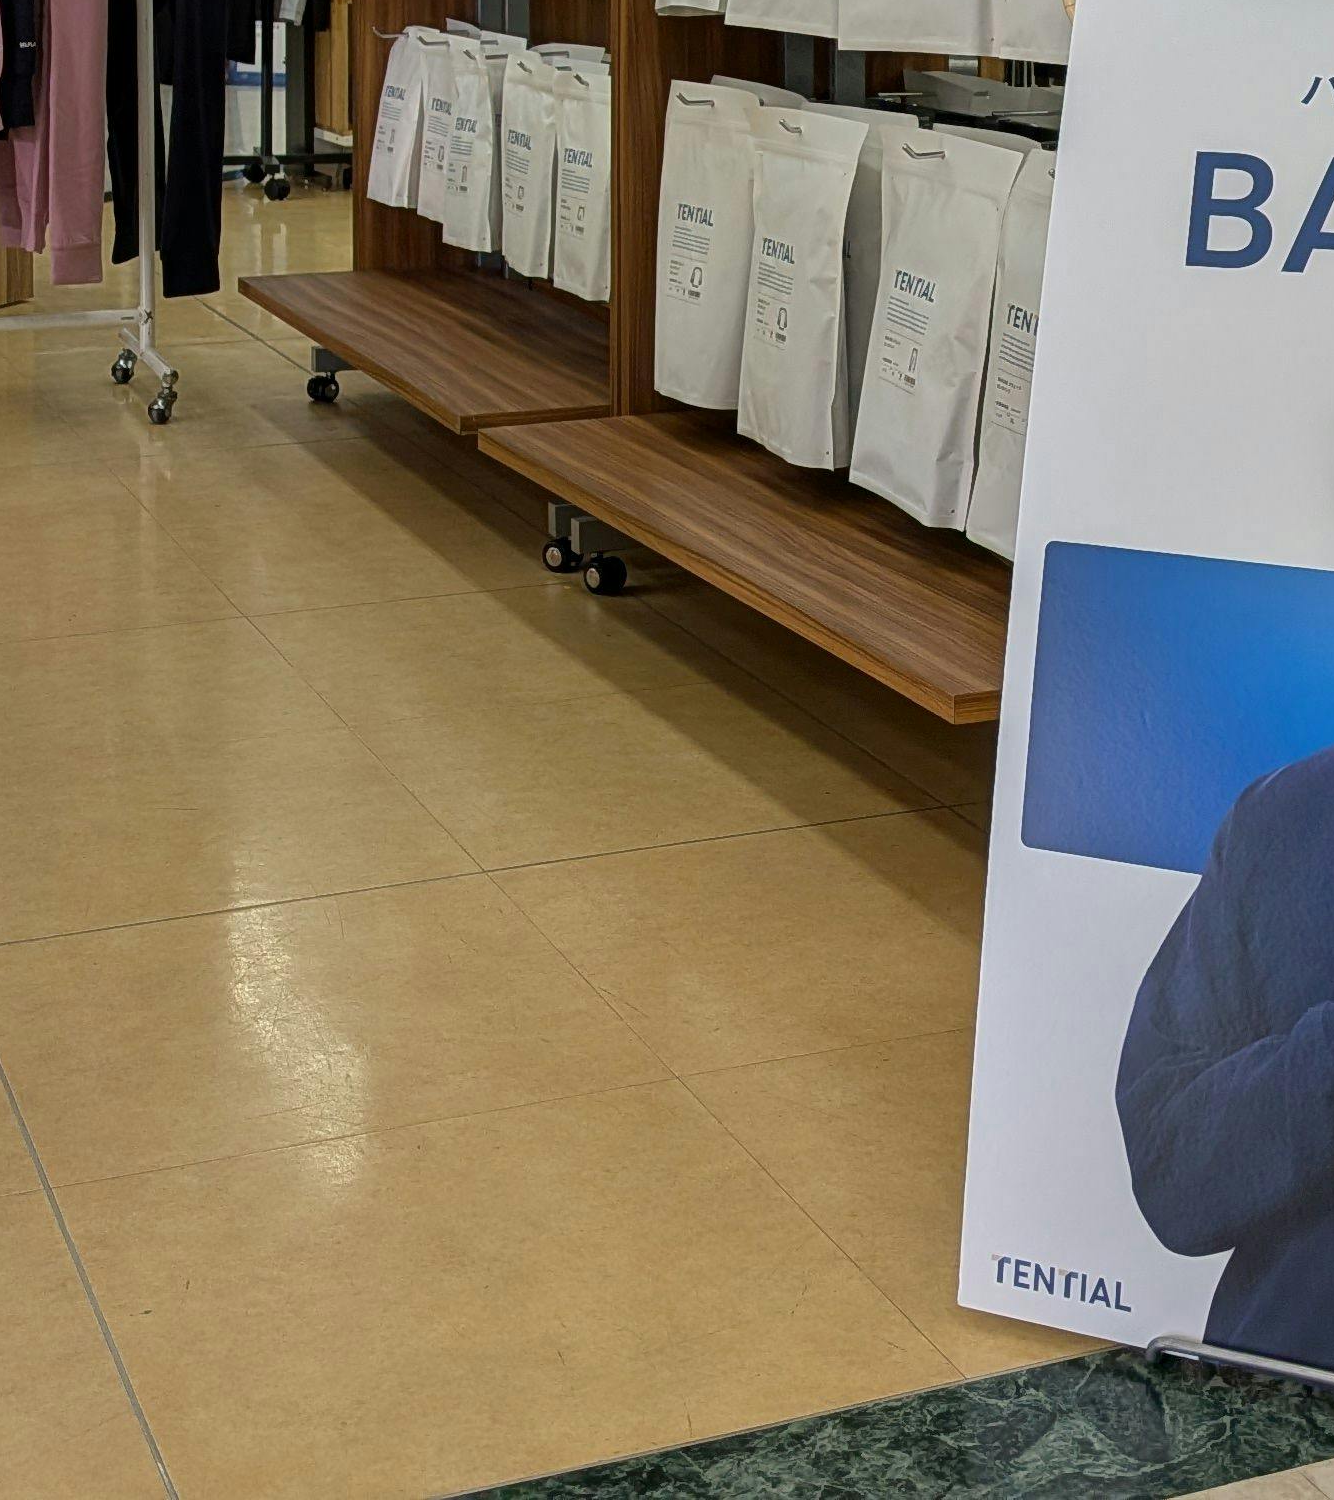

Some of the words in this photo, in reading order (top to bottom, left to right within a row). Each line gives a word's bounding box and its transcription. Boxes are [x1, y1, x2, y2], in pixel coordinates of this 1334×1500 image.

[563, 148, 593, 168] TENTIAL
[677, 202, 714, 228] TENTIAL
[761, 237, 795, 265] TENTIAL
[893, 269, 937, 305] TENTIAL
[991, 1252, 1133, 1313] TENTIAL
